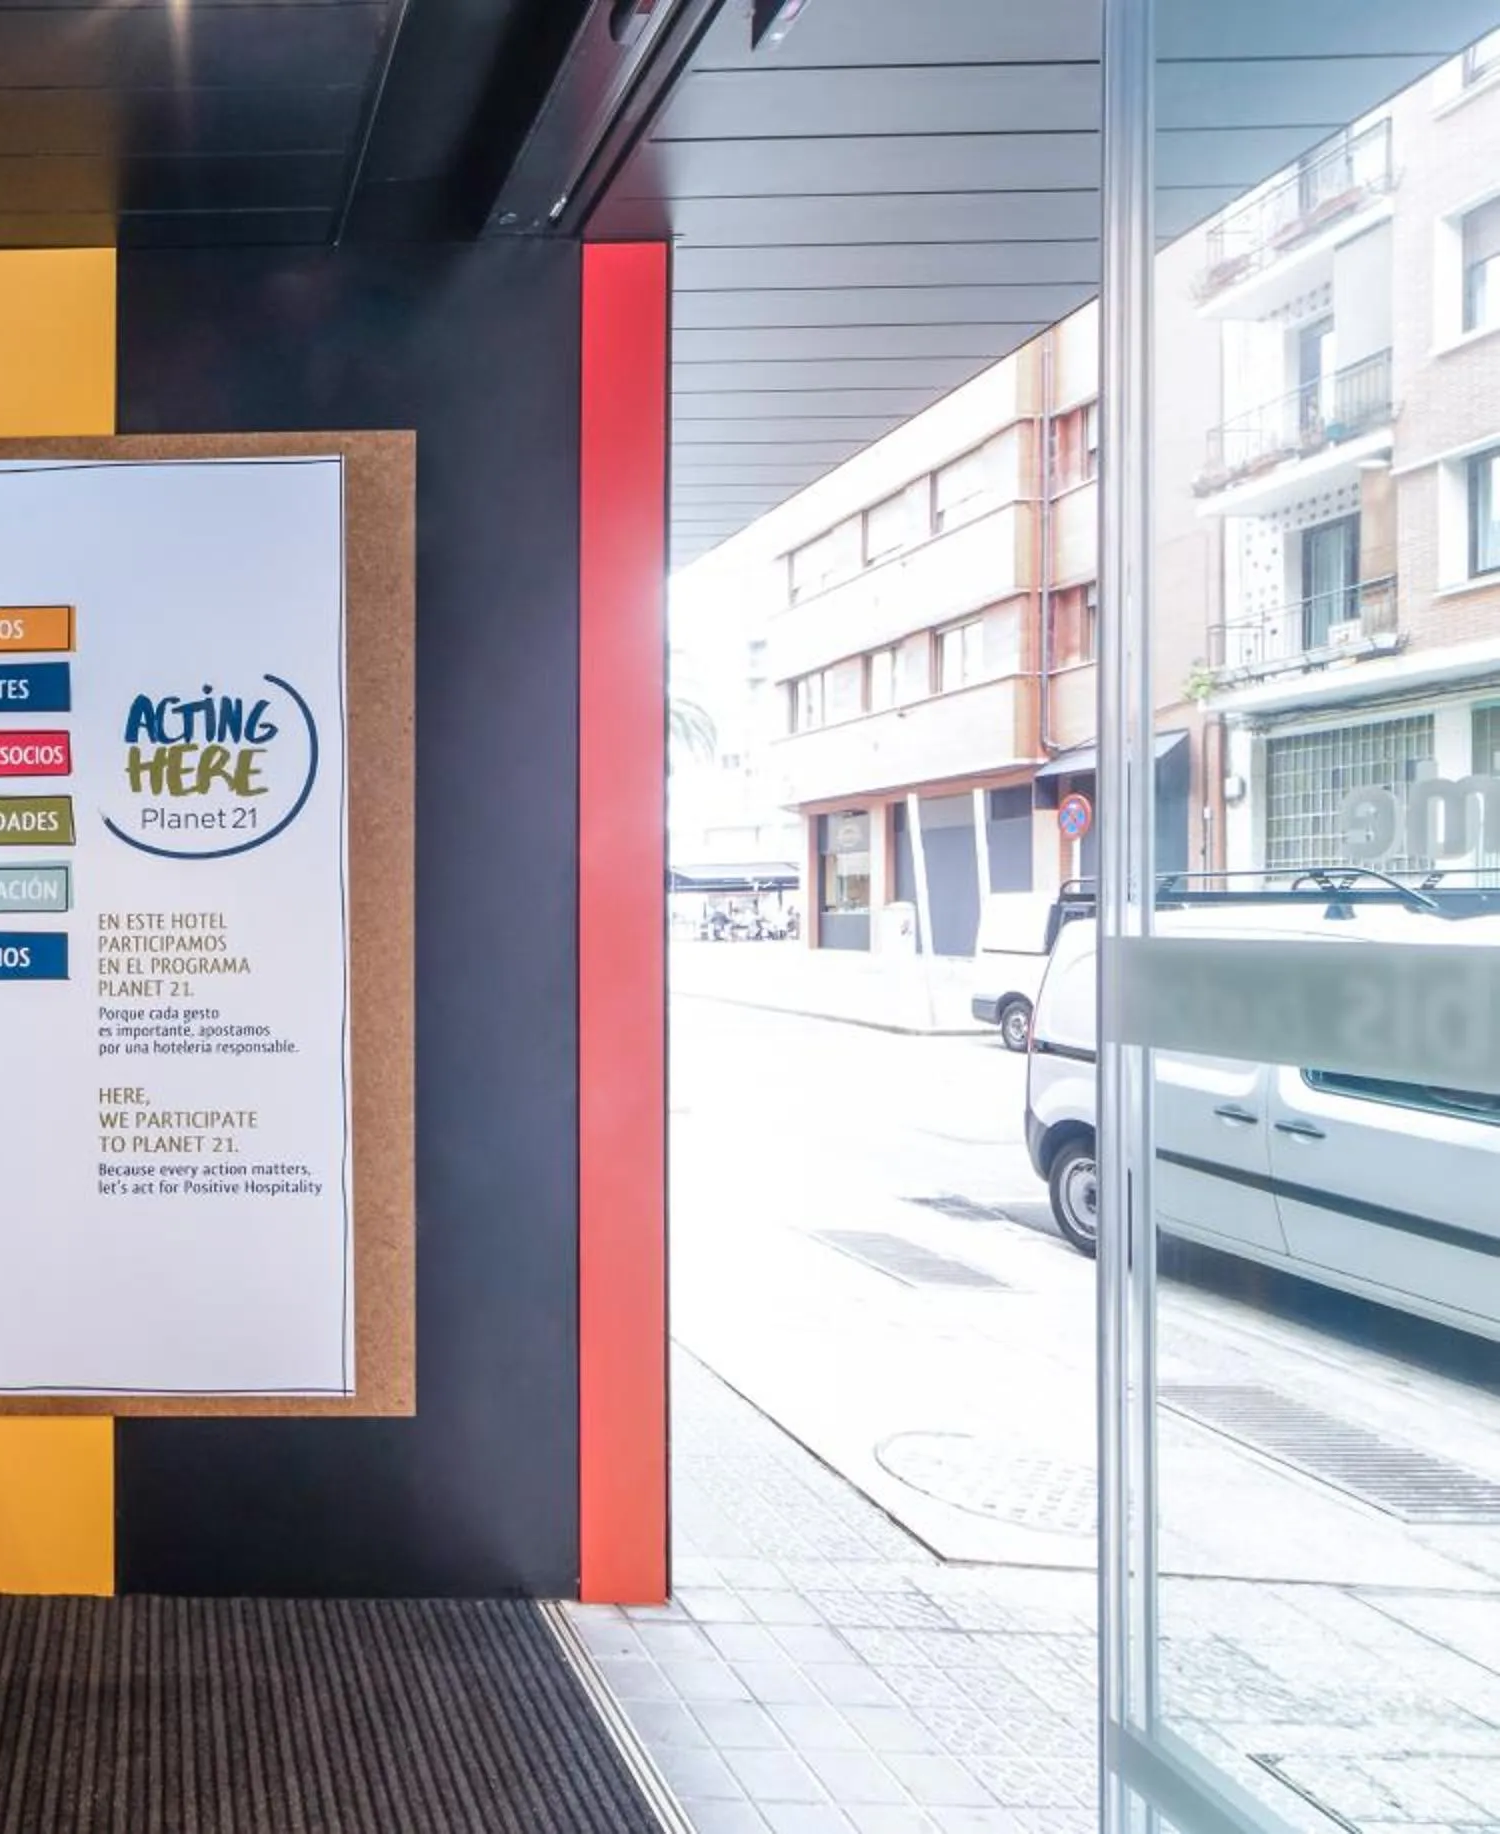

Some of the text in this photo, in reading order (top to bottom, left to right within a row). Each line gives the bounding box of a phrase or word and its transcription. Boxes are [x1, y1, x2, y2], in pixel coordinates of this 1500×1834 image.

[124, 684, 279, 745] ACTING
[124, 742, 269, 798] HERE
[141, 807, 258, 830] Planet 21
[98, 913, 228, 930] EN ESTE HOTEL
[98, 935, 228, 952] PARTICIPAMOS
[98, 958, 251, 974] EN EL PROGRAMA
[98, 980, 195, 997] PLANET 21.
[98, 1007, 219, 1024] Porque cada gesto
[98, 1026, 113, 1037] es
[199, 1025, 271, 1040] apostamos
[98, 1043, 121, 1056] por
[125, 1043, 149, 1054] una
[98, 1088, 151, 1106] HERE,
[98, 1112, 258, 1129] WE PARTICIPATE
[98, 1136, 239, 1153] TO PLANET 21.
[98, 1163, 155, 1177] Because
[159, 1165, 199, 1179] every
[202, 1163, 247, 1177] action
[131, 1182, 154, 1195] act
[159, 1180, 180, 1195] for
[183, 1180, 240, 1195] Positive
[244, 1180, 323, 1197] Hospitality
